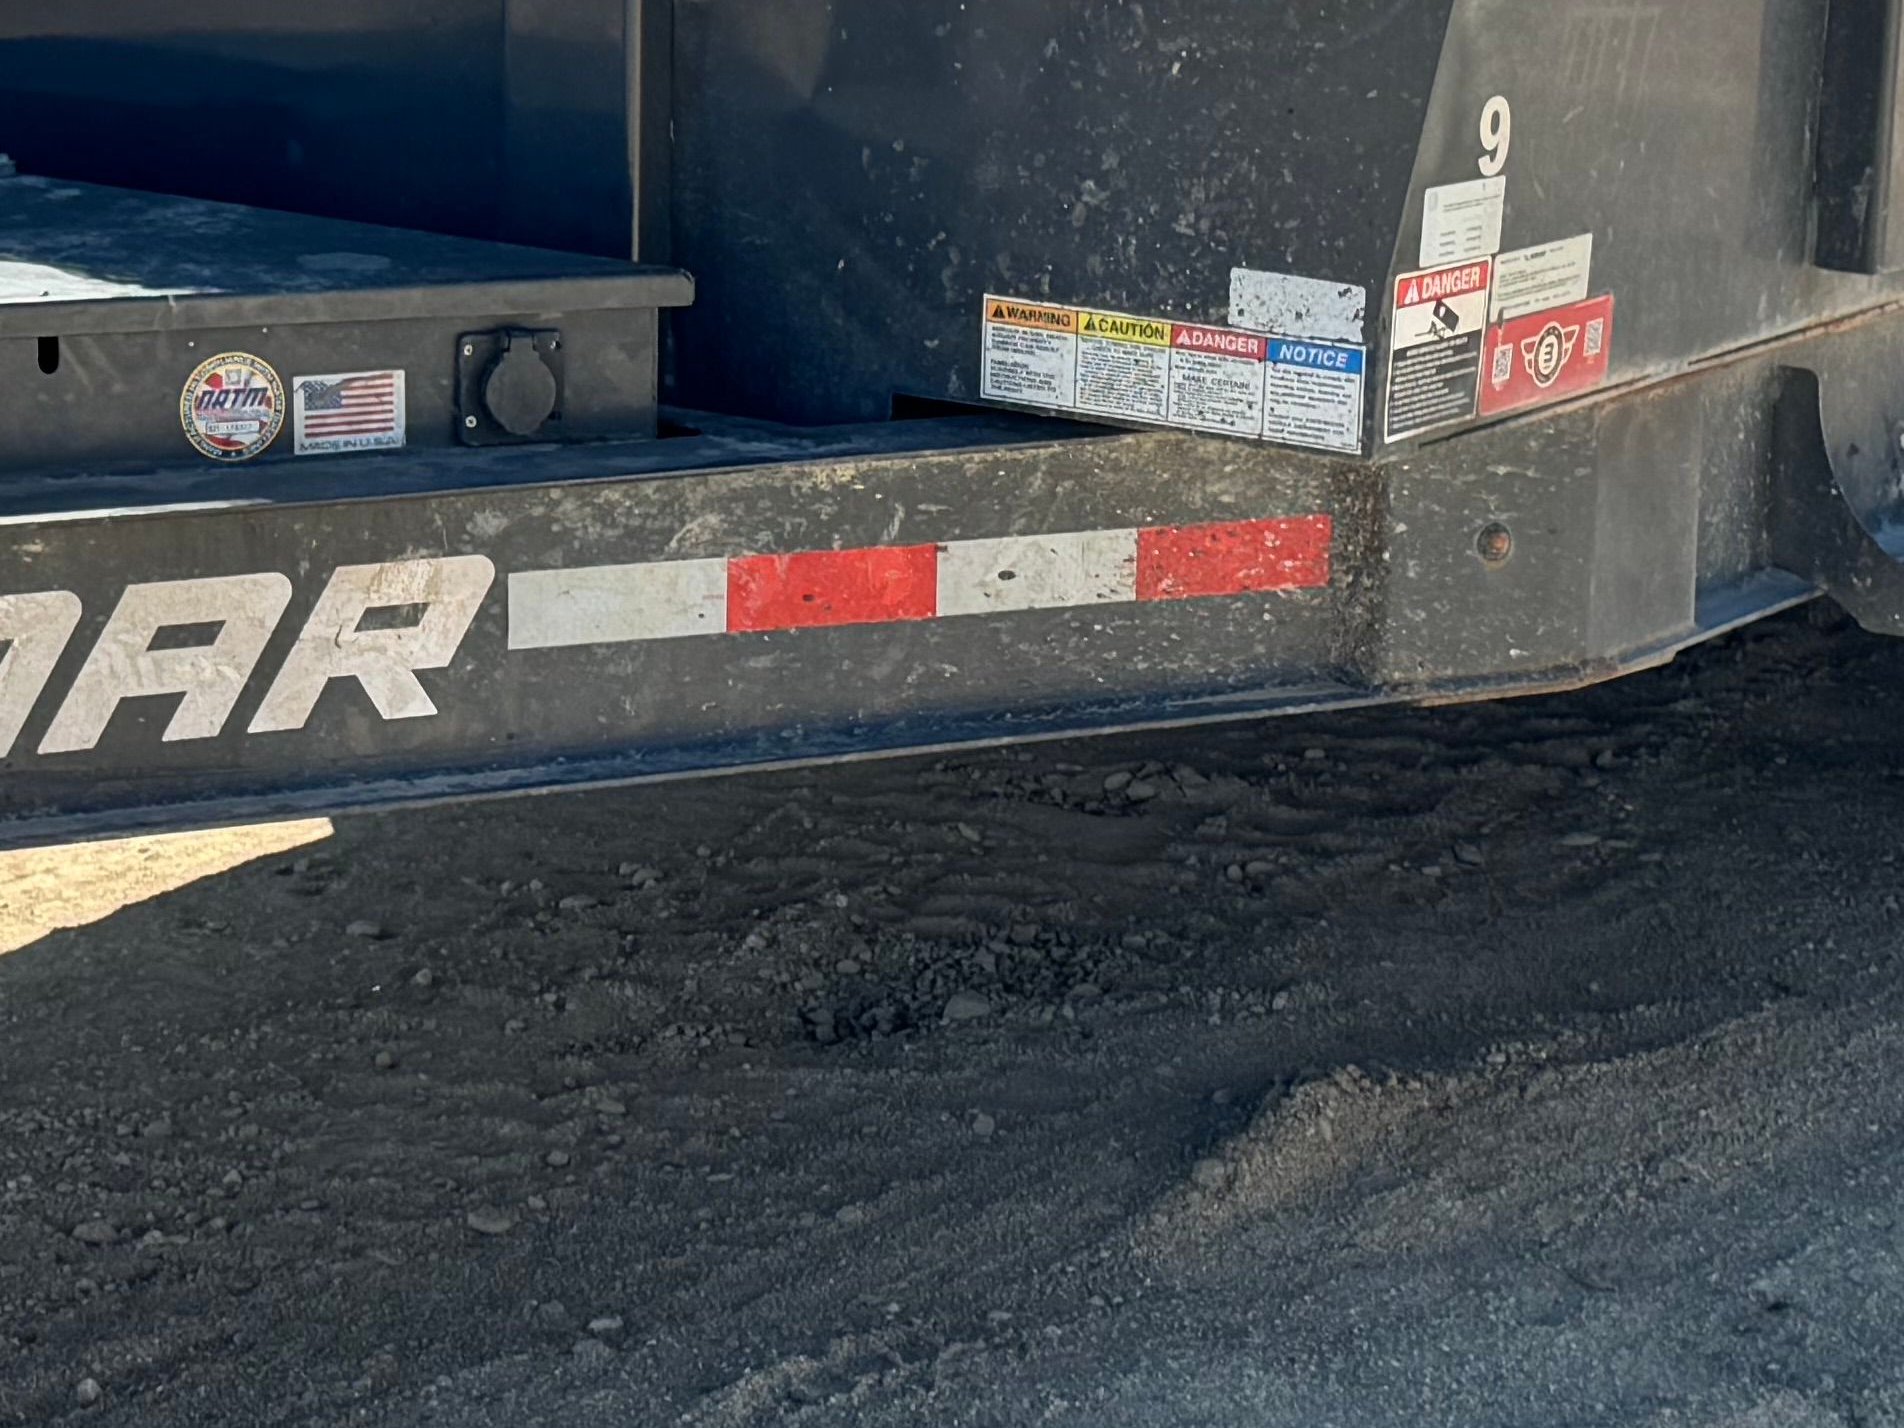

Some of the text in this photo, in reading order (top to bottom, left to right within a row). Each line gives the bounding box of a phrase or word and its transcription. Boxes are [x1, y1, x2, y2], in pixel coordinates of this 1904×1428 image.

[1478, 95, 1511, 177] 9
[1421, 266, 1480, 300] DANGER
[1006, 306, 1071, 327] WARNING
[1099, 318, 1164, 341] CAUTION
[1192, 331, 1258, 354] DANGER
[1279, 344, 1348, 368] NOTICE
